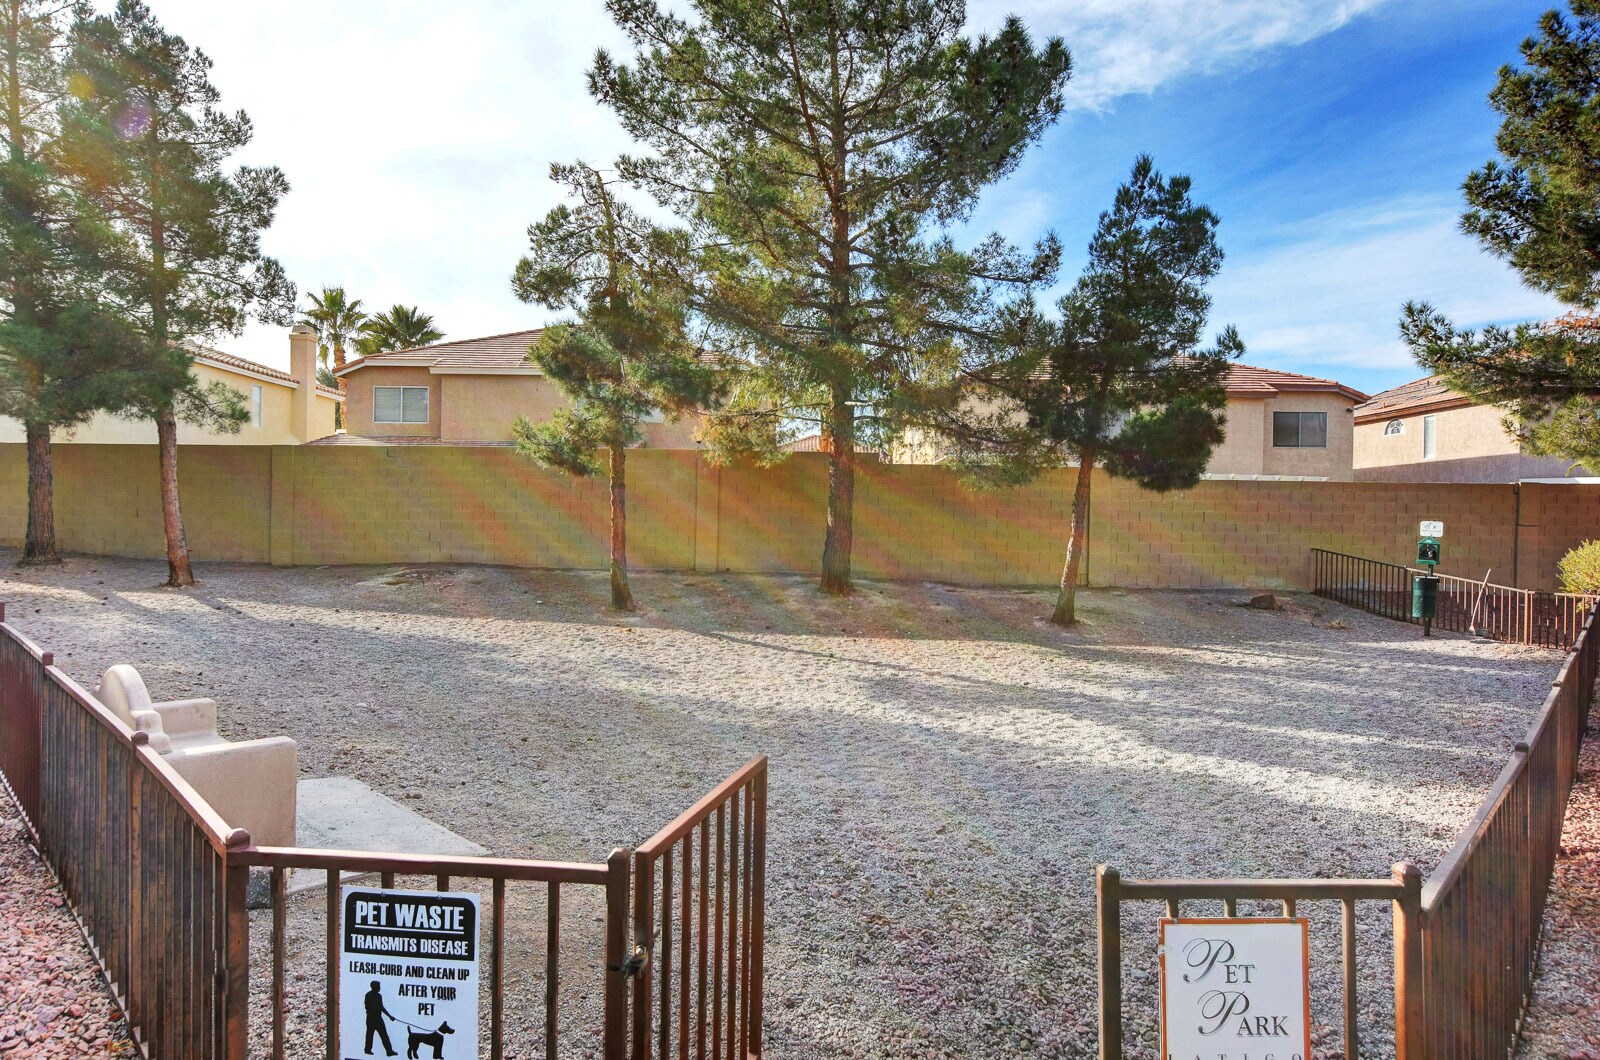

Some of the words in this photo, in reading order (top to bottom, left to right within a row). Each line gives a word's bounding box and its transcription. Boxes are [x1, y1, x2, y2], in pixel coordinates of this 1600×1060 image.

[355, 900, 389, 925] PET
[395, 903, 464, 930] WASTE
[351, 933, 417, 953] TRANSMITS
[420, 938, 468, 956] DISEASE
[405, 965, 425, 979] AND
[426, 967, 455, 980] CLEAN
[457, 969, 470, 981] UP
[398, 983, 428, 998] AFTER
[431, 985, 456, 1001] YOUR
[418, 1002, 435, 1016] PET
